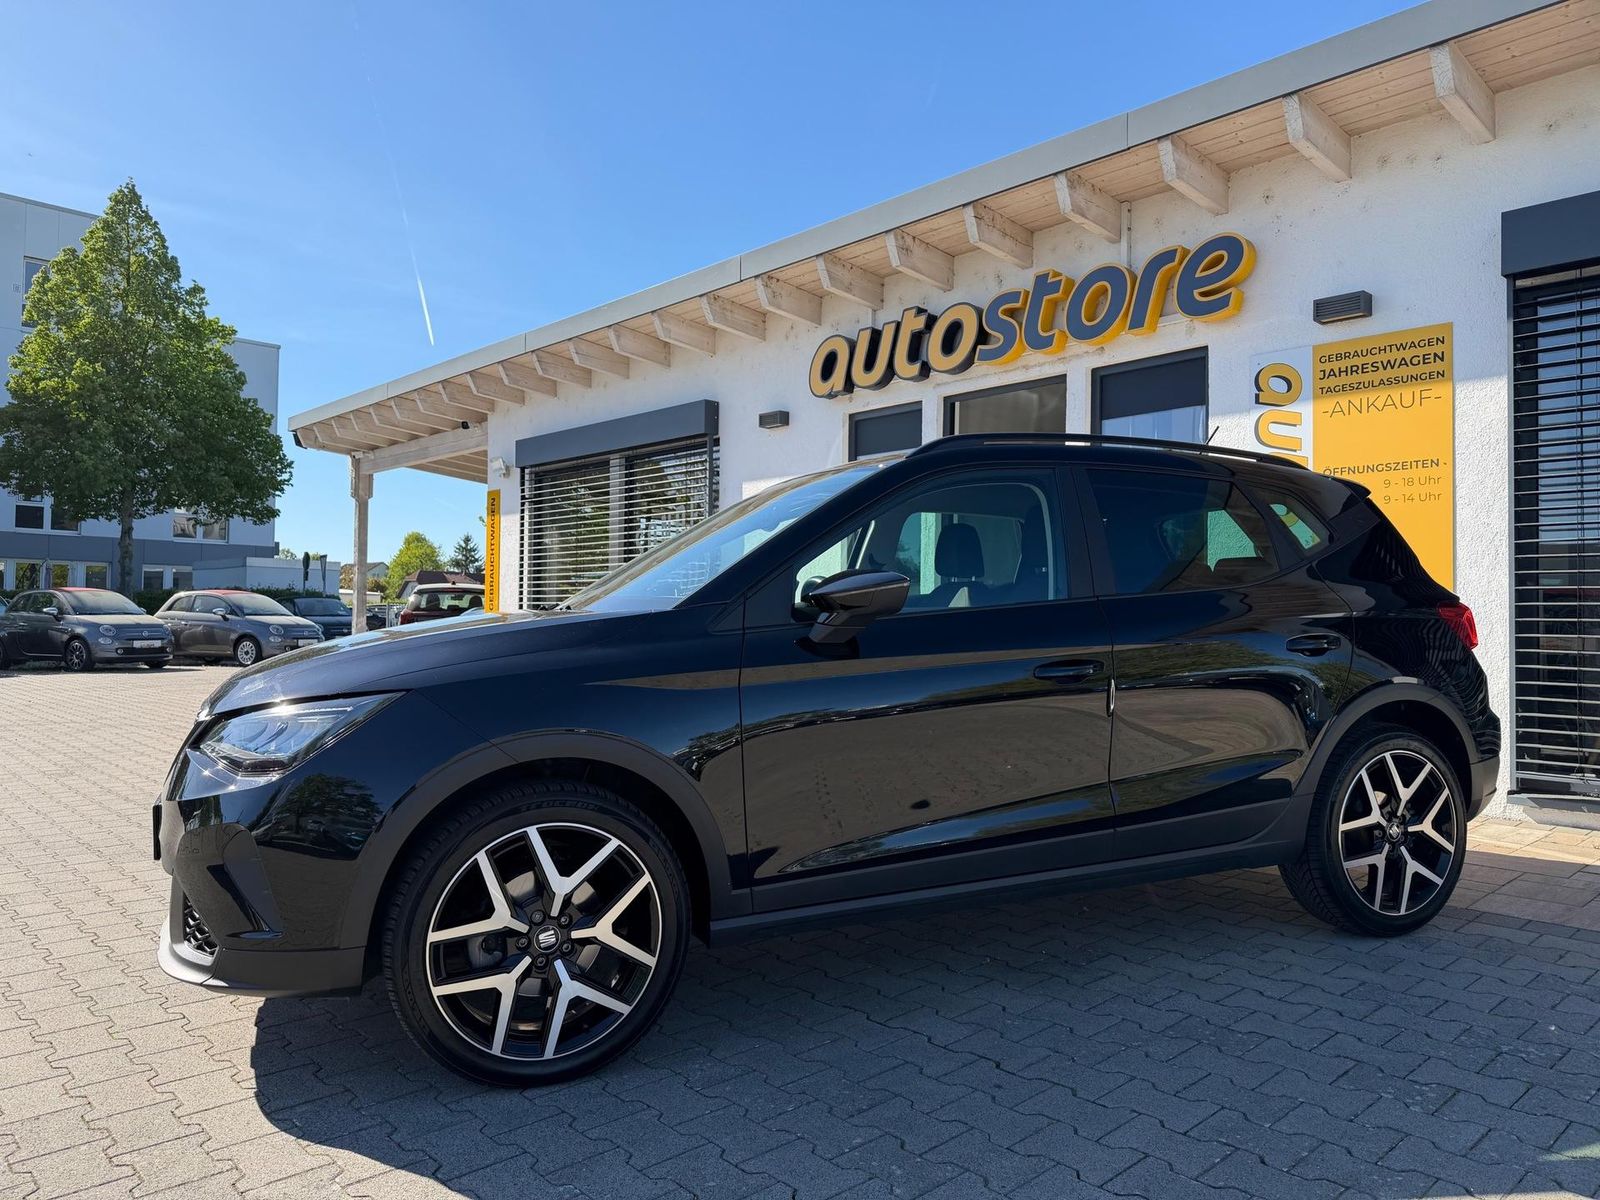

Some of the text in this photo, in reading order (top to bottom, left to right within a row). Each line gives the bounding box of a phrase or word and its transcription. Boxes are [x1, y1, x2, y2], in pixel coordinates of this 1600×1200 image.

[809, 232, 1256, 399] autostore
[1319, 336, 1445, 364] GEBRAUCHTWAGEN
[1319, 351, 1445, 380] JAHRESWAGEN
[1319, 370, 1445, 395] TAGESZULASSUNGEN
[1323, 458, 1440, 477] ÖFFNUNGSZEITEN
[1383, 478, 1391, 489] 9
[1402, 476, 1415, 488] 18
[1418, 474, 1442, 487] Uhr
[1383, 494, 1391, 505] 9
[1402, 492, 1415, 504] 14
[1418, 490, 1442, 503] Uhr
[488, 497, 496, 611] GEBRAUCHTWAGEN
